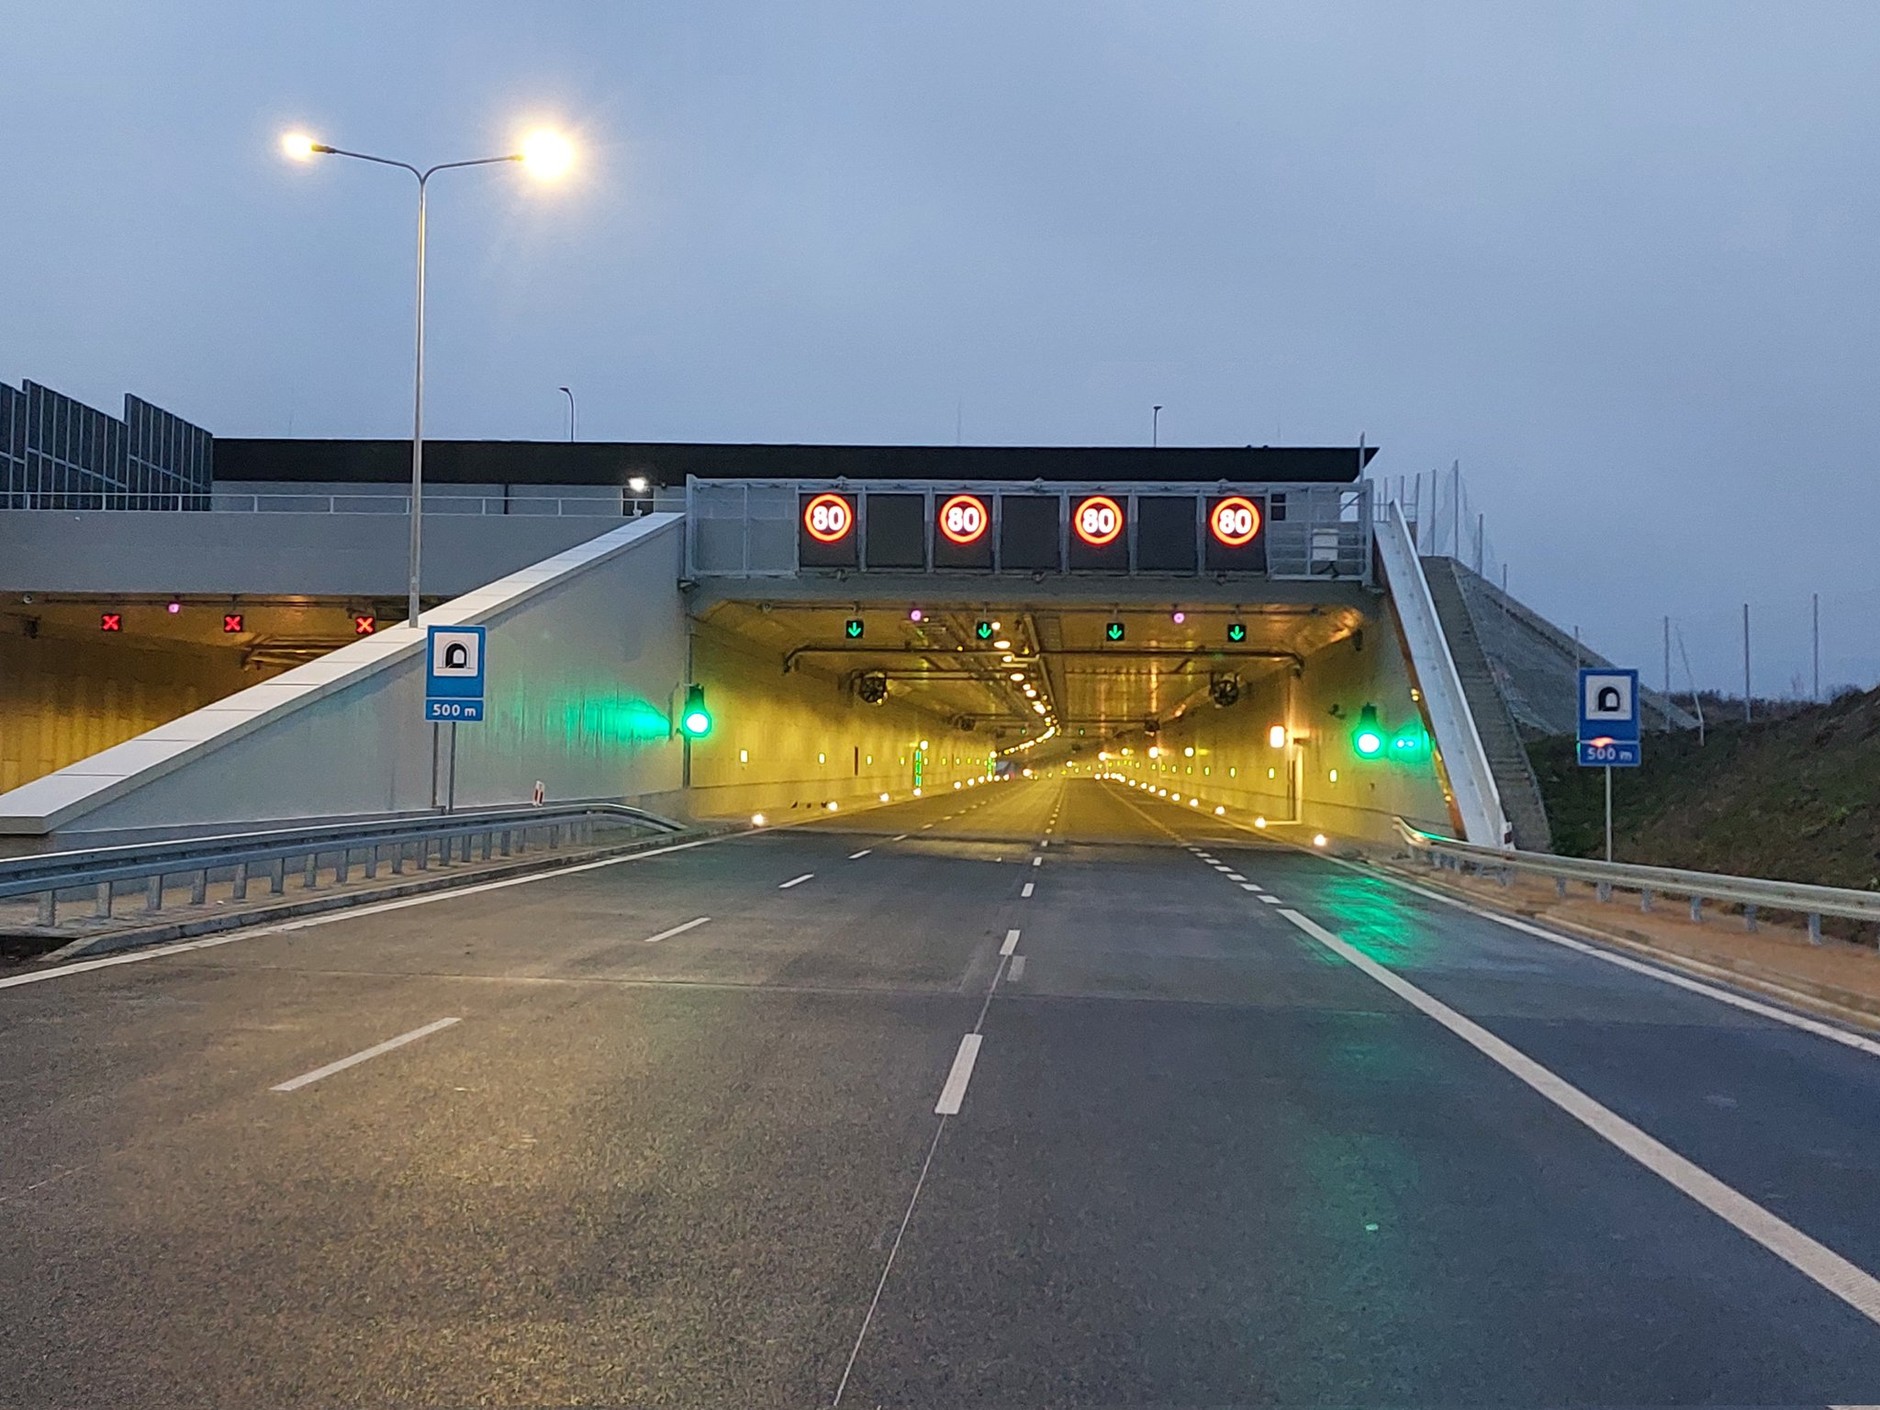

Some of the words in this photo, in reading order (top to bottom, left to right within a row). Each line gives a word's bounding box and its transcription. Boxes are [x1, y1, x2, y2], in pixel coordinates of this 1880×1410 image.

[812, 505, 845, 531] 80
[947, 507, 980, 532] 80
[1082, 508, 1115, 534] 80
[1219, 509, 1252, 534] 80
[432, 703, 461, 716] 500
[464, 707, 476, 717] m
[1587, 745, 1616, 760] 500
[1619, 750, 1633, 761] m
